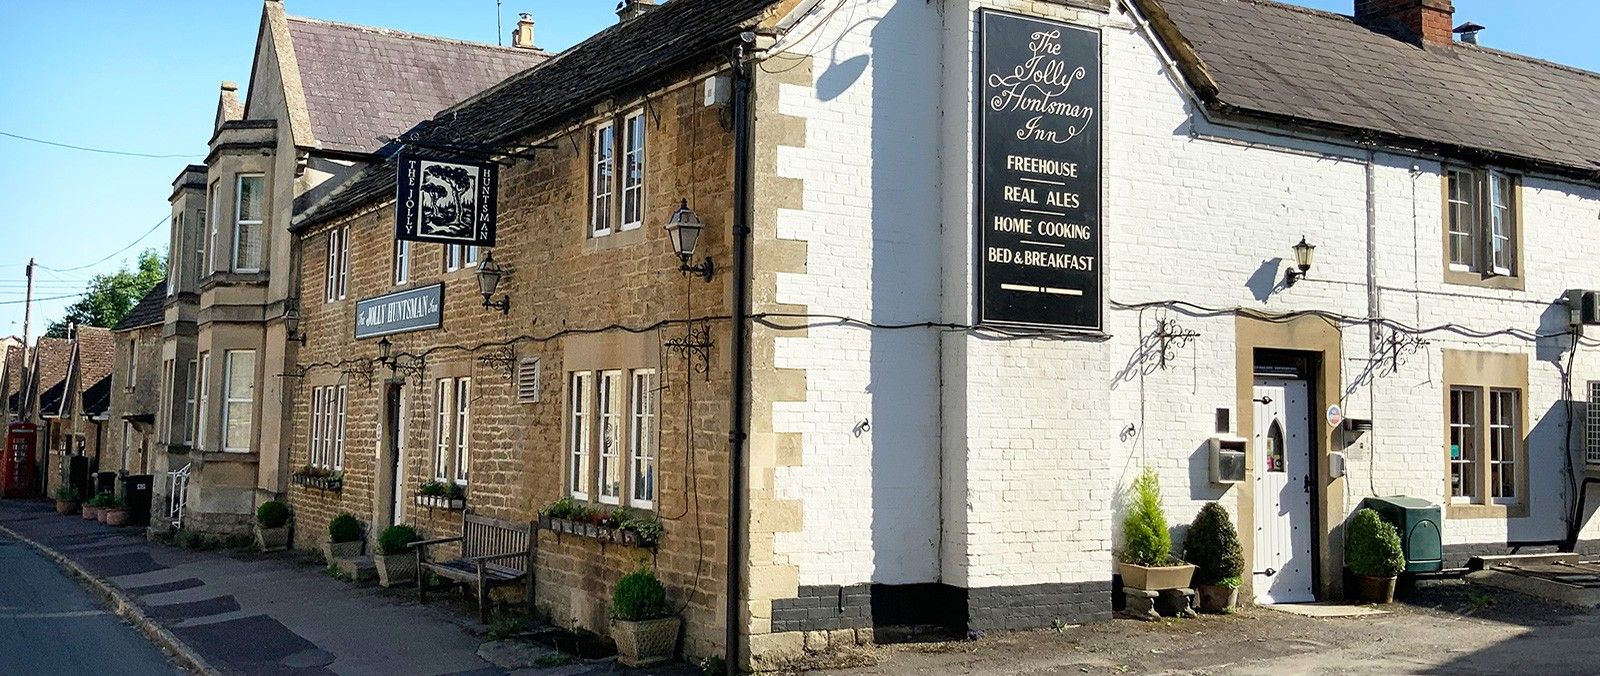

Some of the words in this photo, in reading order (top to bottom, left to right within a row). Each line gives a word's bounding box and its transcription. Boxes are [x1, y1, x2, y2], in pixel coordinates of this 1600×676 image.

[1029, 30, 1062, 55] The
[1014, 55, 1086, 91] Jolly
[989, 82, 1093, 119] Huntsman
[1017, 116, 1068, 143] Inn
[408, 160, 416, 186] THE
[1007, 155, 1078, 178] FREEHOUSE
[480, 169, 491, 240] HUNTSMAN
[1004, 185, 1038, 204] REAL
[1046, 191, 1079, 209] ALES
[406, 189, 415, 234] JOLLY
[994, 216, 1032, 234] HOME
[1038, 221, 1090, 240] COOKING
[1025, 250, 1094, 271] BREAKFAST
[366, 304, 386, 327] JOLLY
[387, 295, 428, 323] HUNTSMAN
